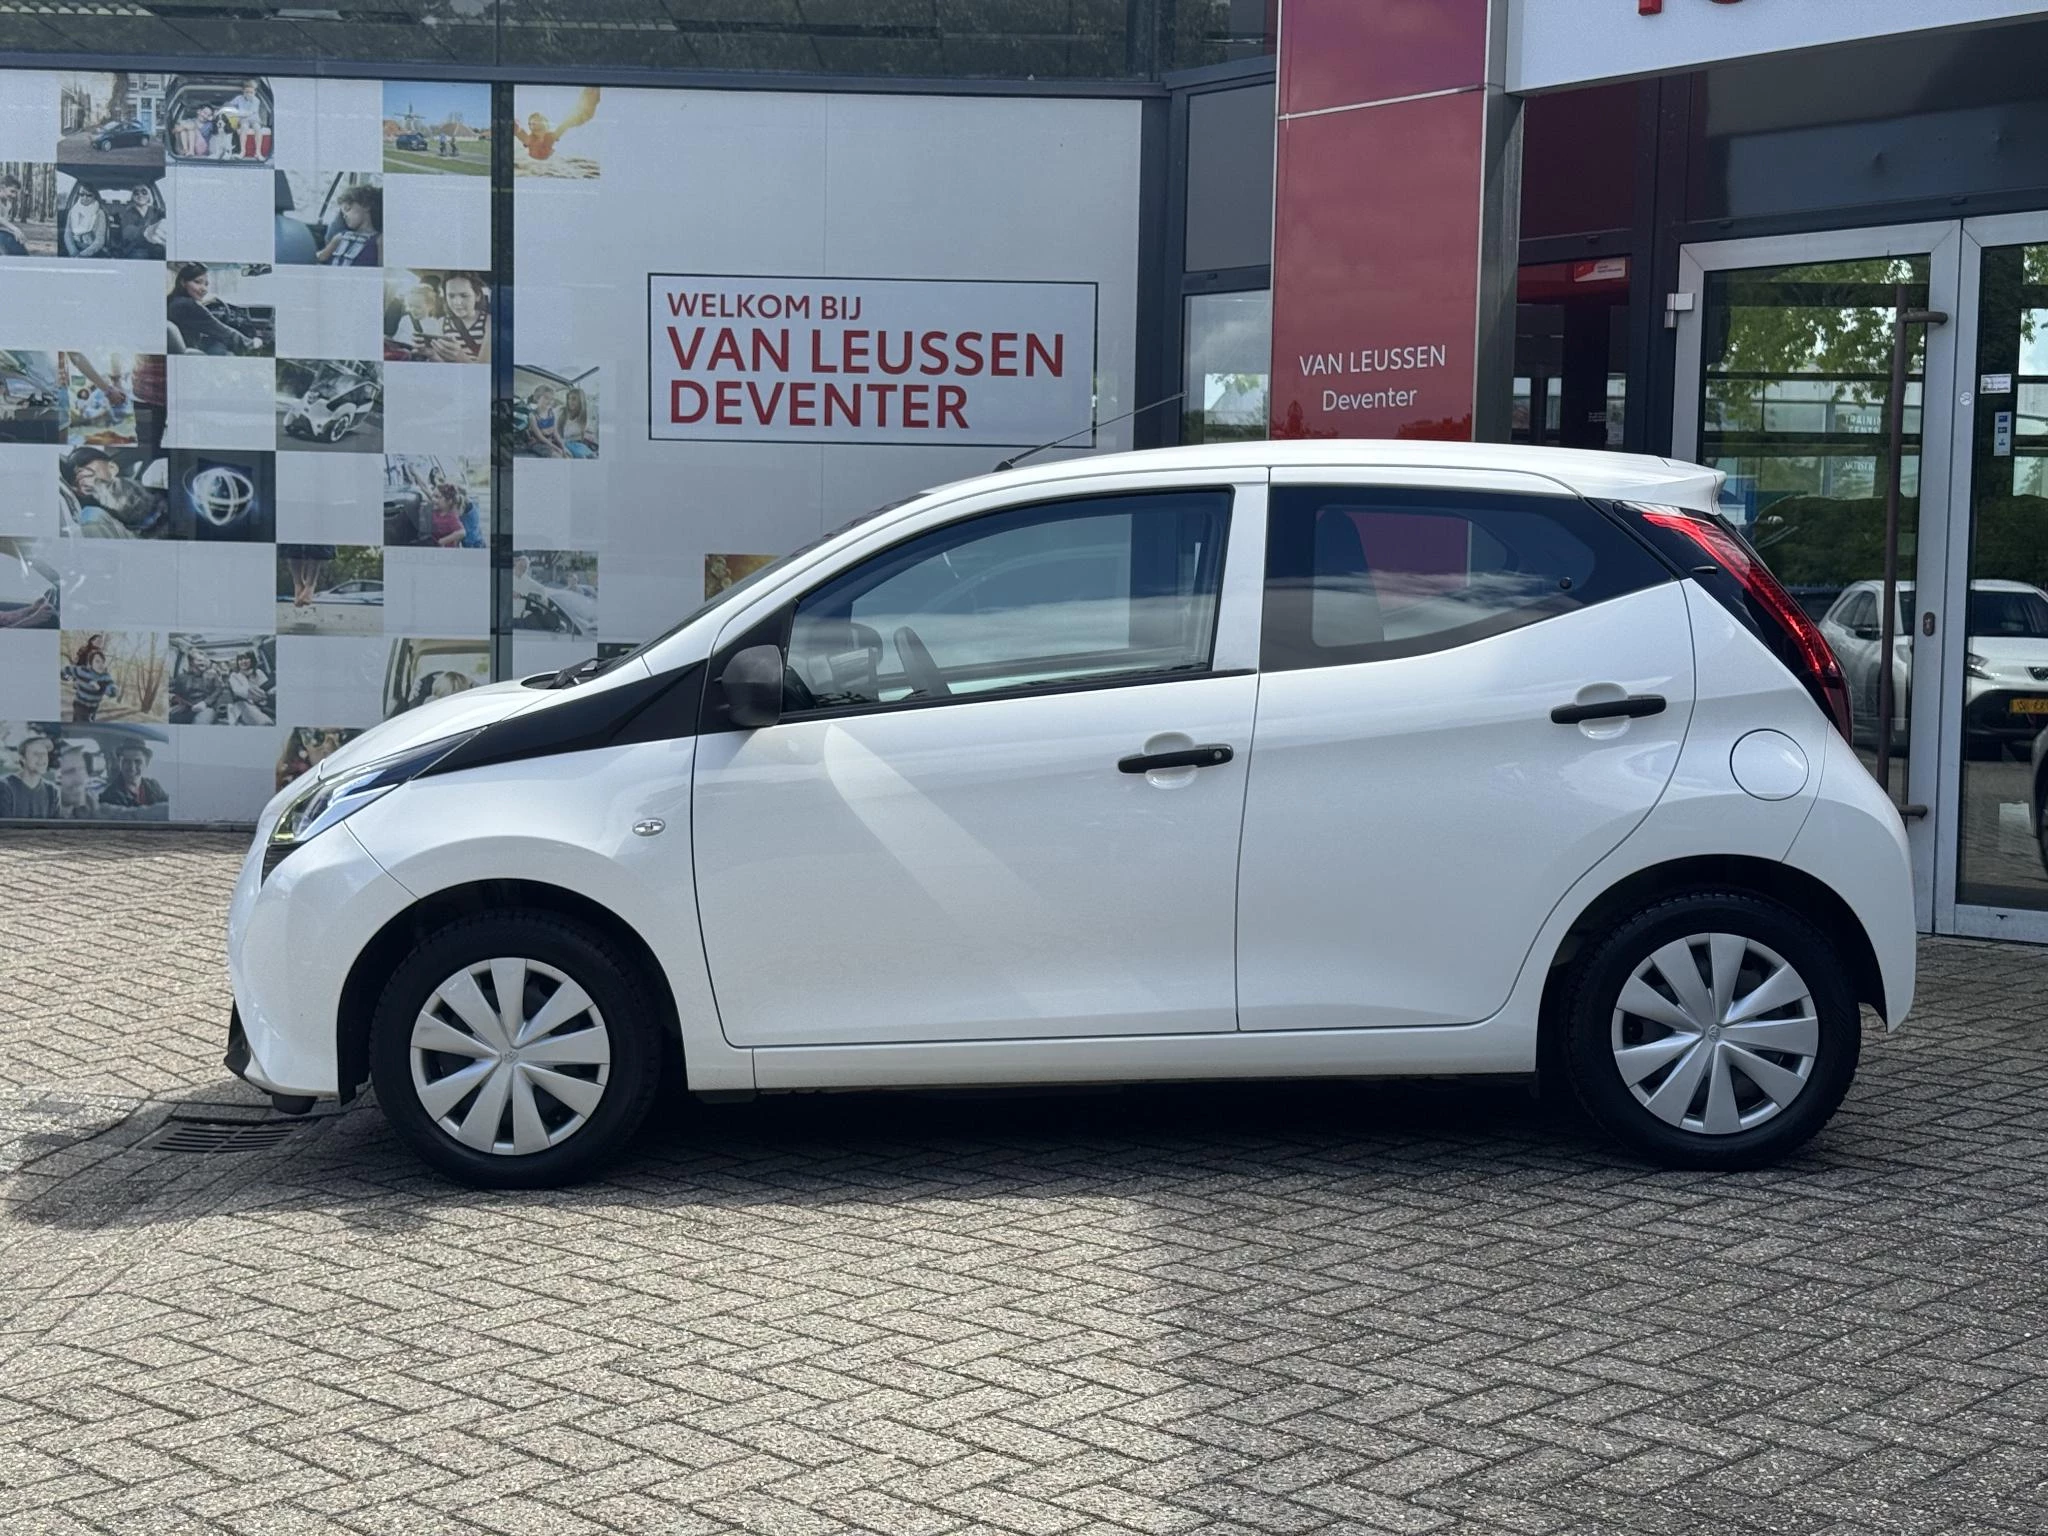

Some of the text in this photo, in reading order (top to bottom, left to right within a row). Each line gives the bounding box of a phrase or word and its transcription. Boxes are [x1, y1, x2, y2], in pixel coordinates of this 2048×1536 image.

[667, 292, 862, 321] WELKOM BIJ
[667, 326, 1065, 378] VAN LEUSSEN
[1299, 344, 1446, 377] VAN LEUSSEN
[670, 379, 970, 430] DEVENTER
[1322, 387, 1418, 412] Deventer
